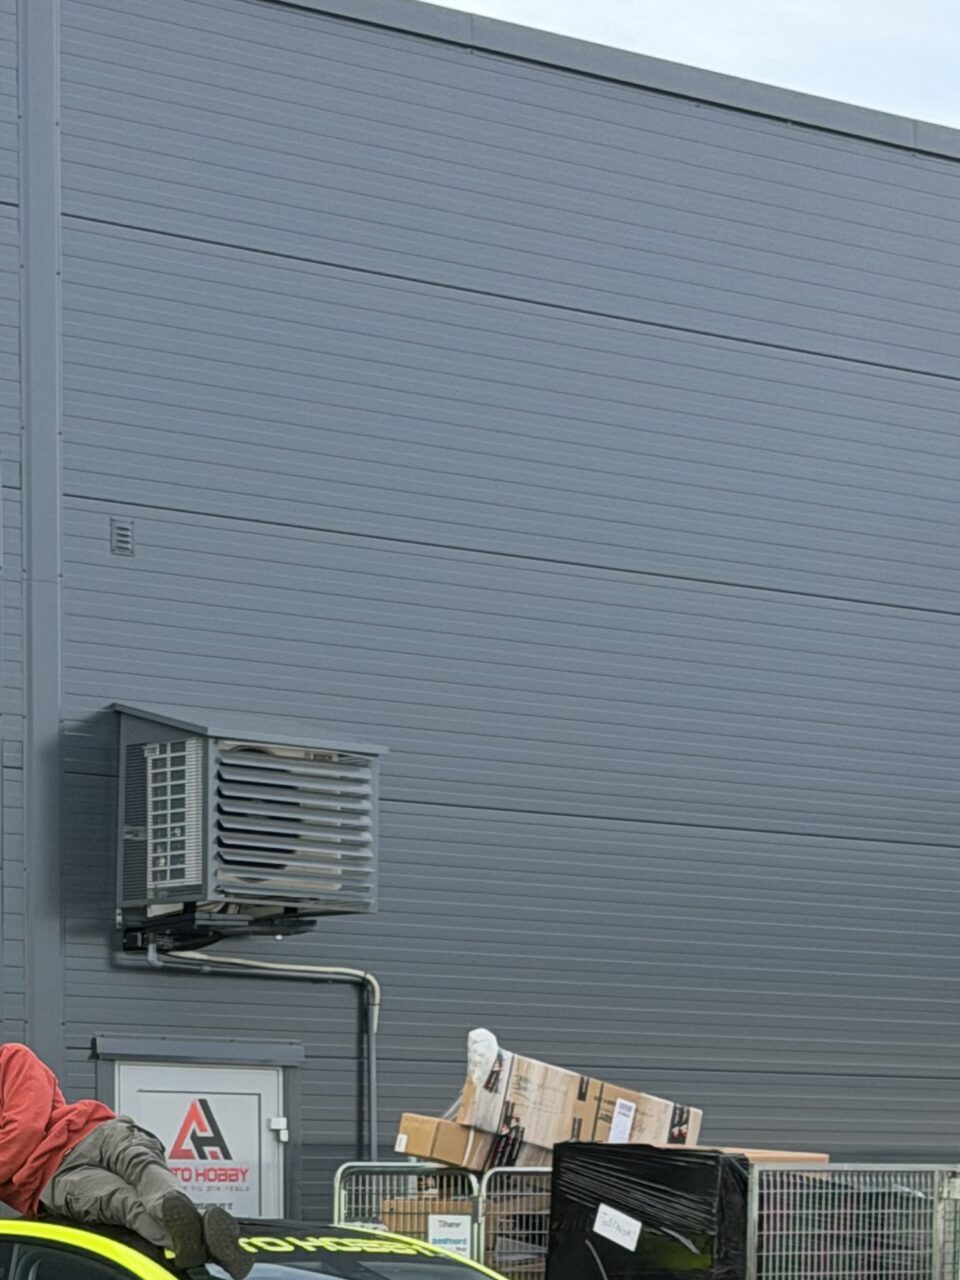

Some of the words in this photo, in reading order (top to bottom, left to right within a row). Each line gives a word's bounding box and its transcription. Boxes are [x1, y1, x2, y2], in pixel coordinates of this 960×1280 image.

[171, 1167, 192, 1182] TO
[195, 1167, 249, 1182] HOBBY
[238, 1237, 294, 1253] TO
[286, 1237, 435, 1257] HOBBY
